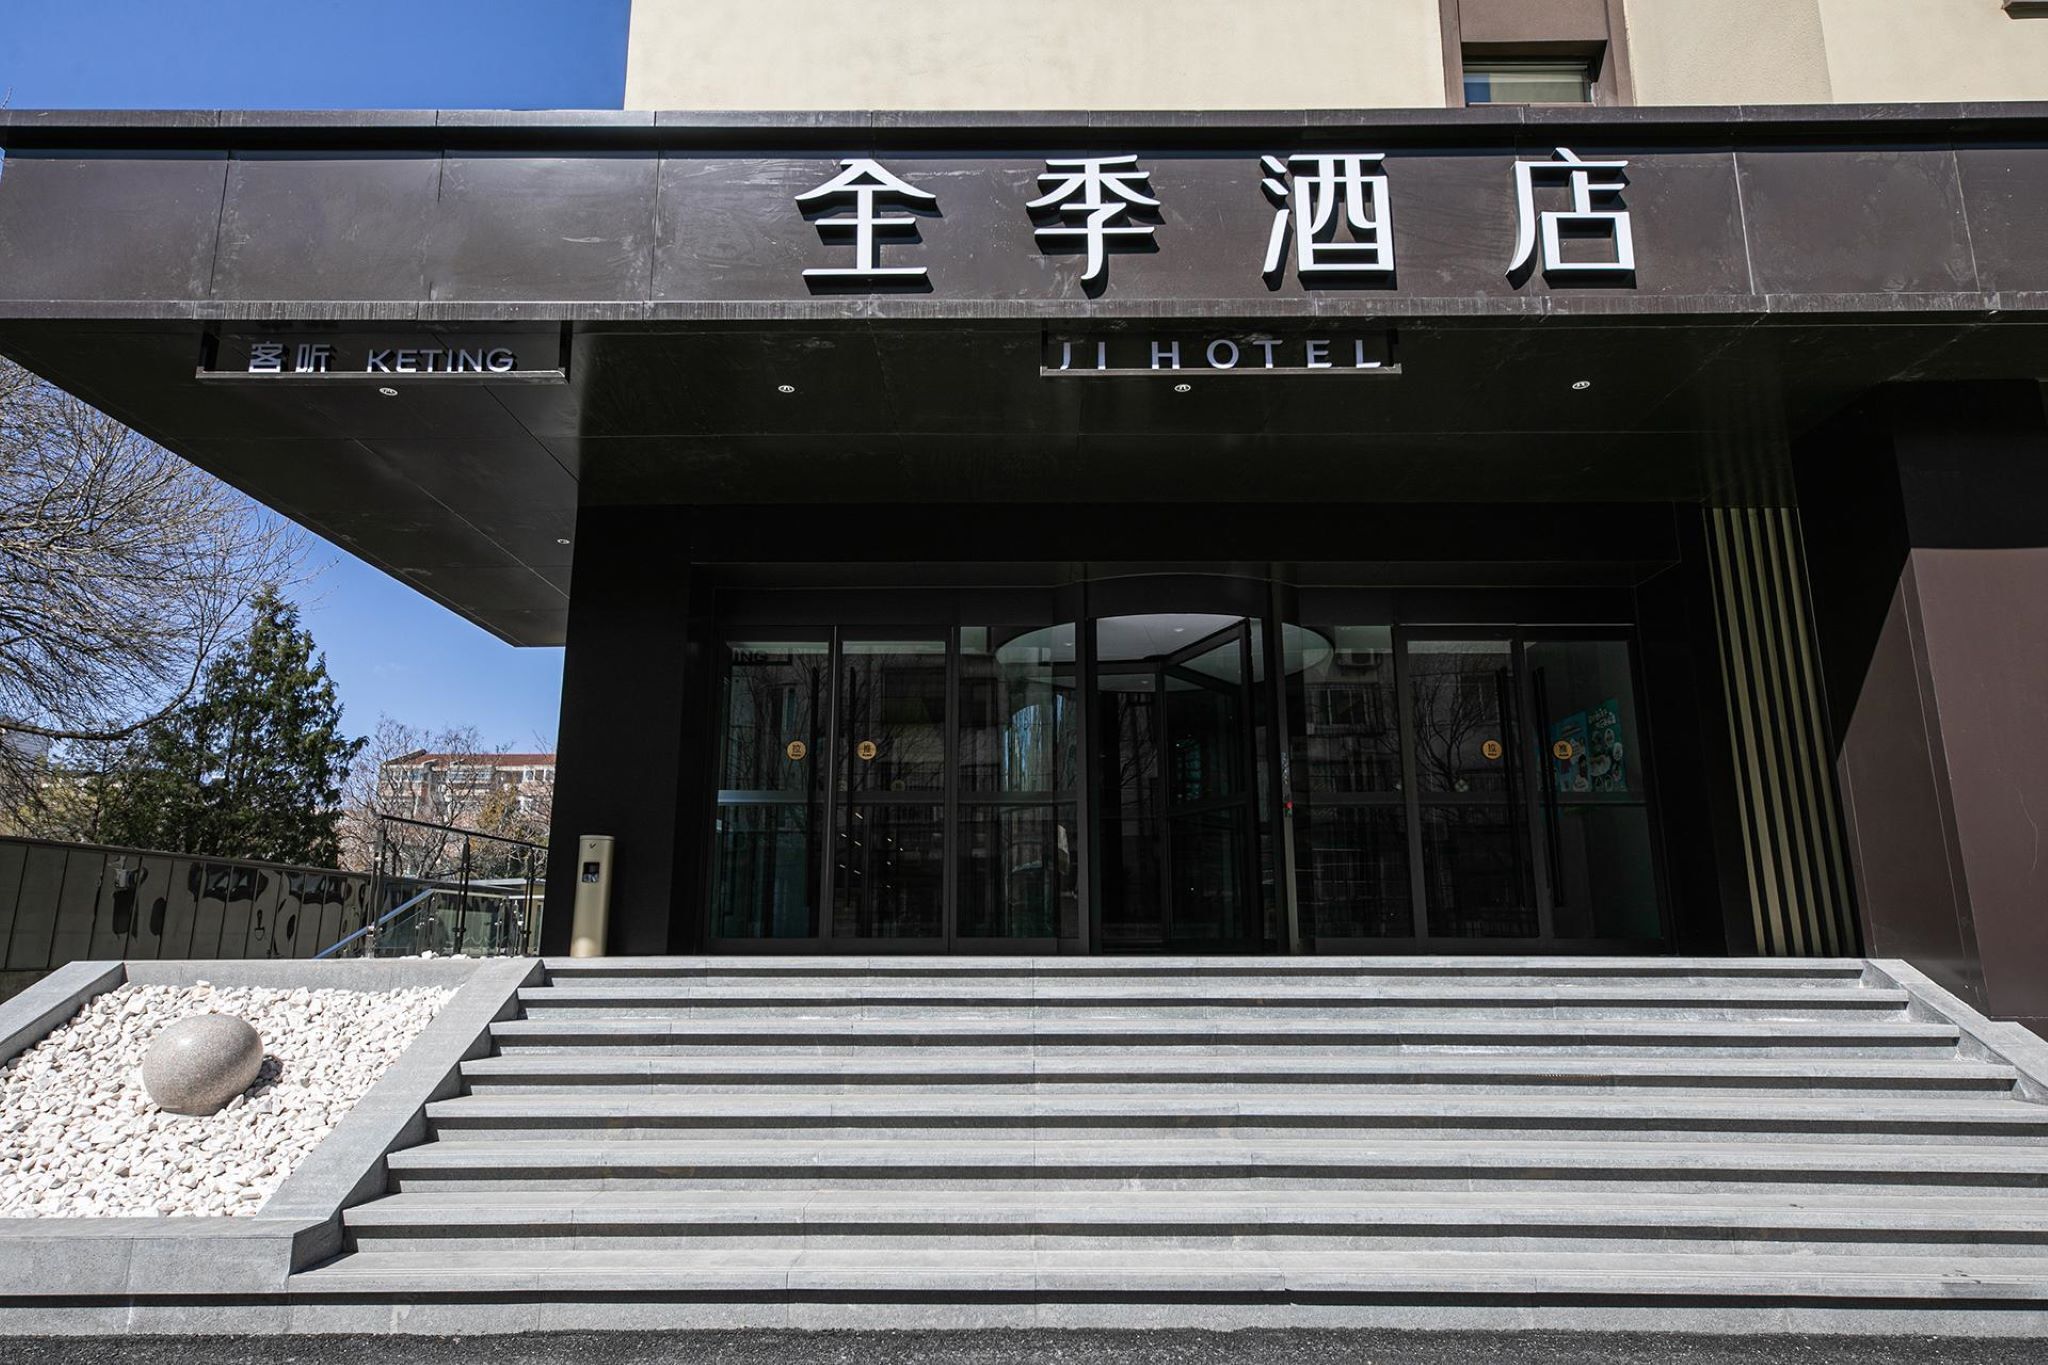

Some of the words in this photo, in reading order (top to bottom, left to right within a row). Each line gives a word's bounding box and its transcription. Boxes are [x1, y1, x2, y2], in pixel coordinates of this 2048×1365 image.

[794, 148, 1636, 282] 全季酒店
[248, 341, 331, 373] 客听
[366, 348, 515, 373] KETING
[1059, 341, 1107, 370] JI
[1151, 338, 1382, 369] HOTEL
